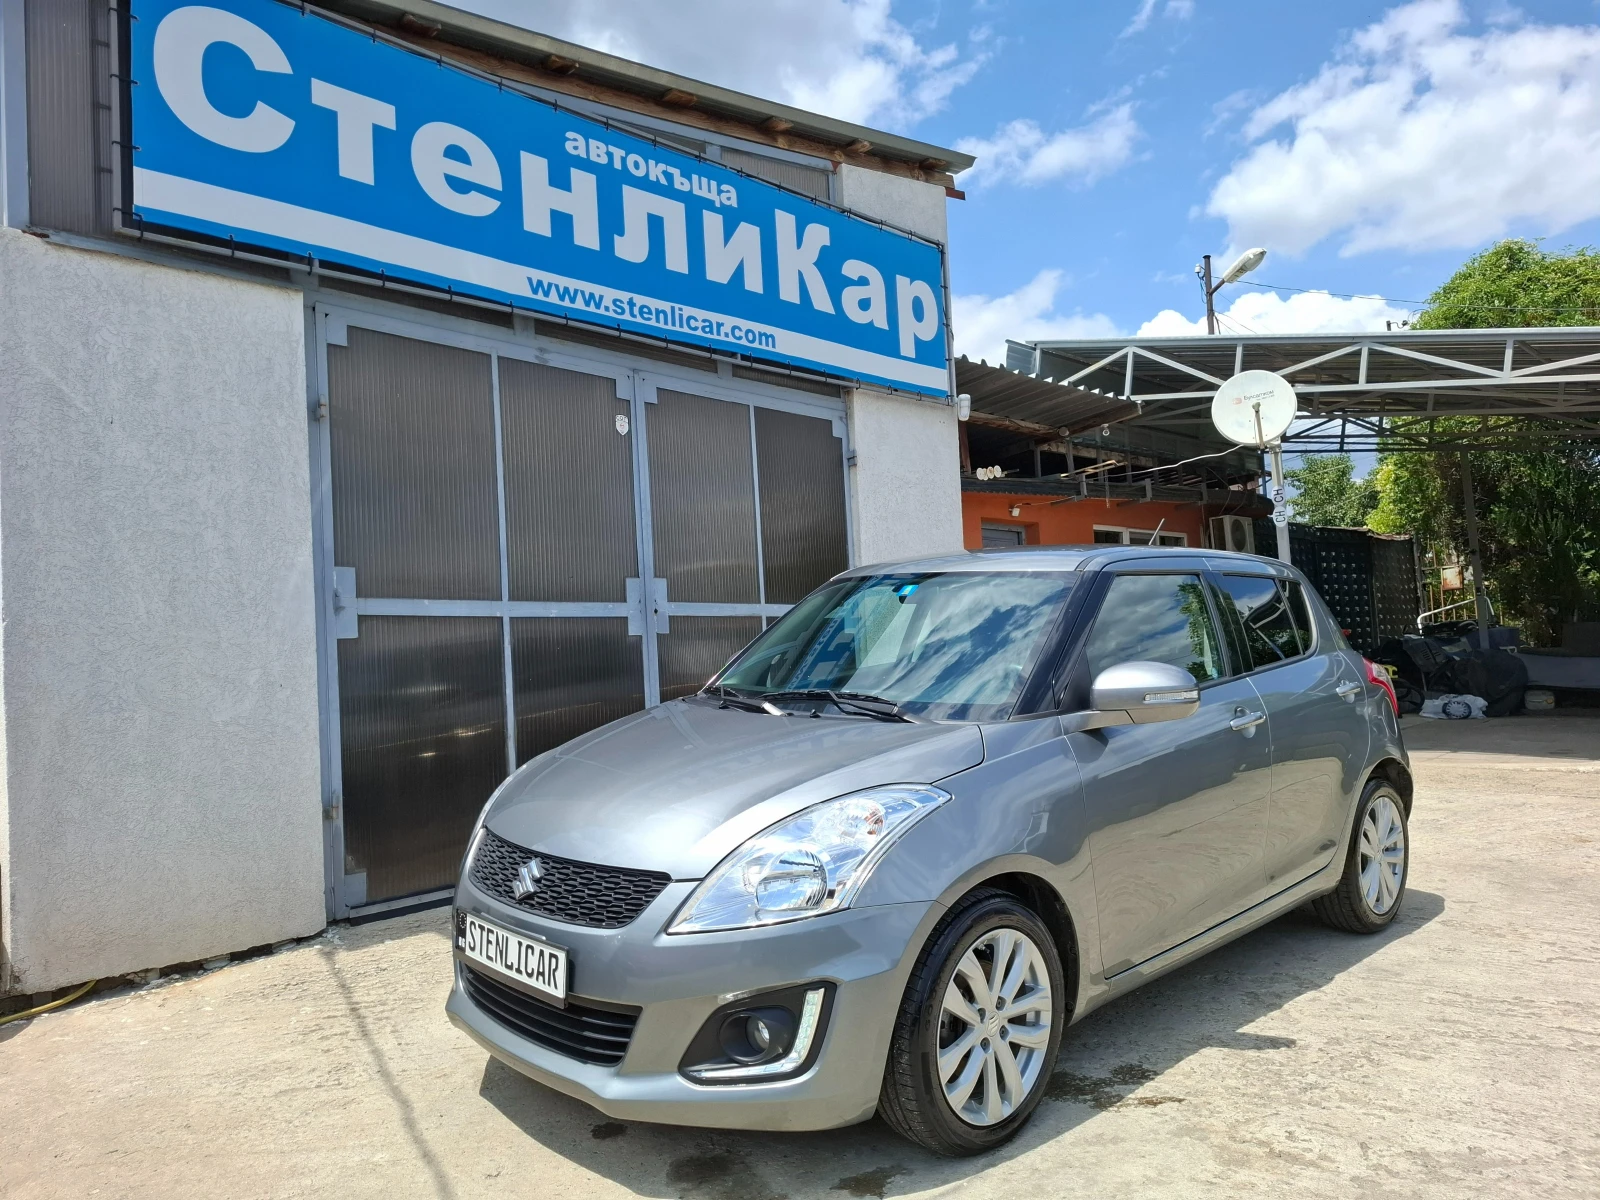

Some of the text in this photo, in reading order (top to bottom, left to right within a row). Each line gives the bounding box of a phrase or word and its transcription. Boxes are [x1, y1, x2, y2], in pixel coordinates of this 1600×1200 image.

[153, 5, 939, 358] СтенлиКар
[564, 130, 738, 208] автокъща
[526, 276, 777, 350] www.stenlicar.com
[468, 920, 560, 990] STENLICAR
